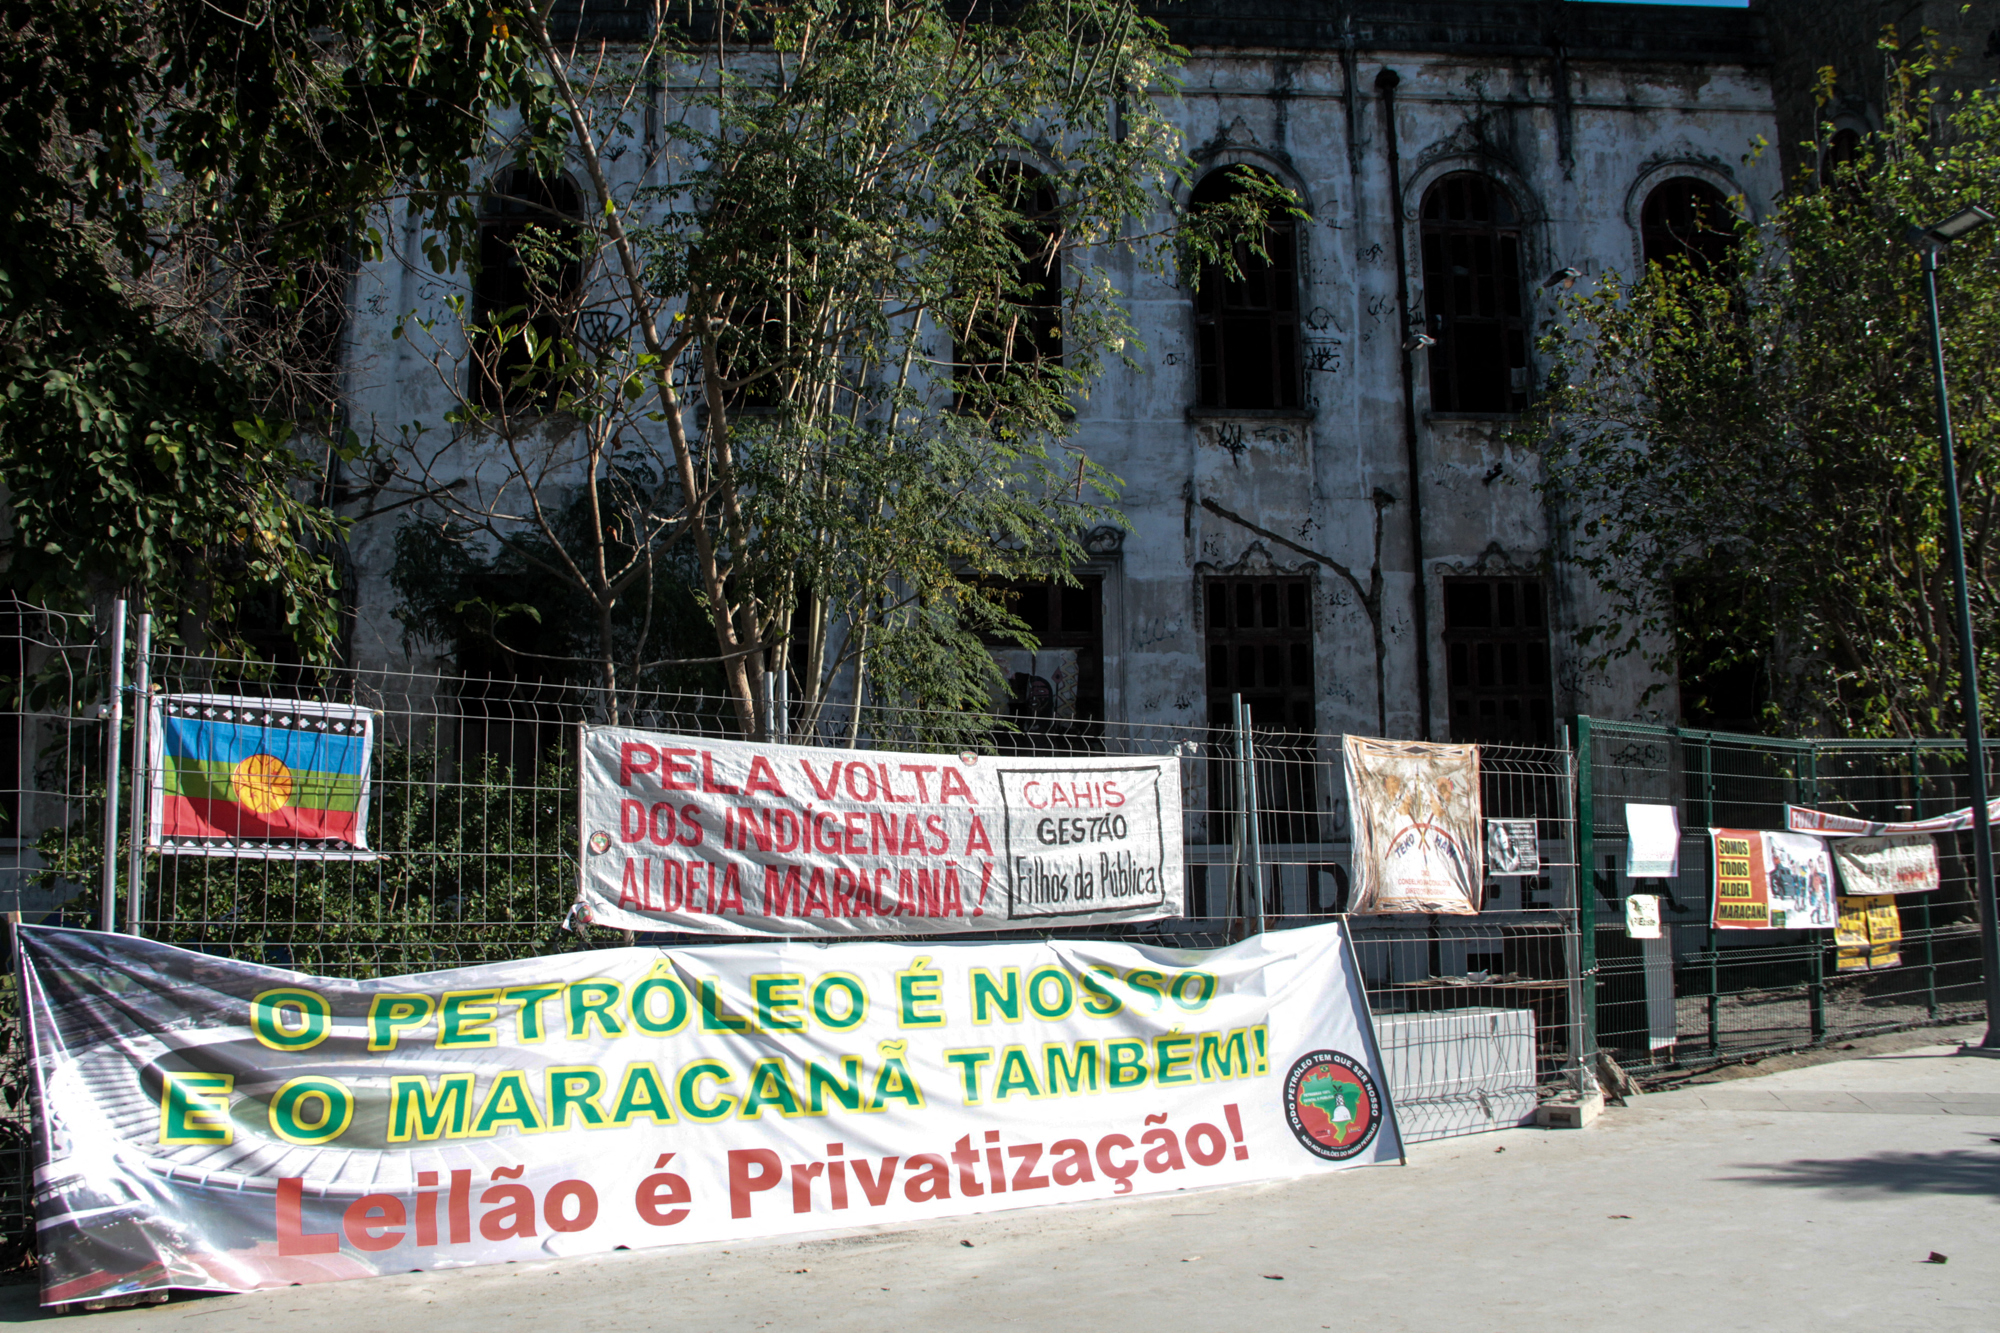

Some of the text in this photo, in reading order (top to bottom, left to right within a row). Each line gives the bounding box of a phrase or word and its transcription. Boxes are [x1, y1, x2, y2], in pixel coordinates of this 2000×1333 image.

[619, 742, 979, 805] PELA VOLTA
[1023, 781, 1126, 809] CAHIS
[619, 798, 994, 857] DOS INDÍGENAS À
[1718, 839, 1748, 855] SOMOS
[1792, 811, 1819, 829] FORA
[618, 857, 745, 916] ALDEIA
[762, 858, 965, 919] MARACANÃ
[1016, 850, 1157, 905] Filhos da Pública
[1719, 861, 1748, 876] TODOS
[1720, 882, 1750, 897] ALDEIA
[1718, 902, 1768, 919] MARACANÃ
[250, 955, 1220, 1052] O PETRÓLEO É NOSSO
[158, 1022, 1270, 1146] E O MARACANÃ TAMBÉM!
[1288, 1053, 1379, 1131] TODO PETRÓLEO TEM QUE SER NOSSO
[1301, 1134, 1312, 1147] NÃO
[1311, 1143, 1321, 1153] AOS
[1347, 1144, 1362, 1155] NOSSO
[1360, 1123, 1378, 1148] PETRÓLEO
[275, 1103, 1250, 1256] Leilão é Privatização!
